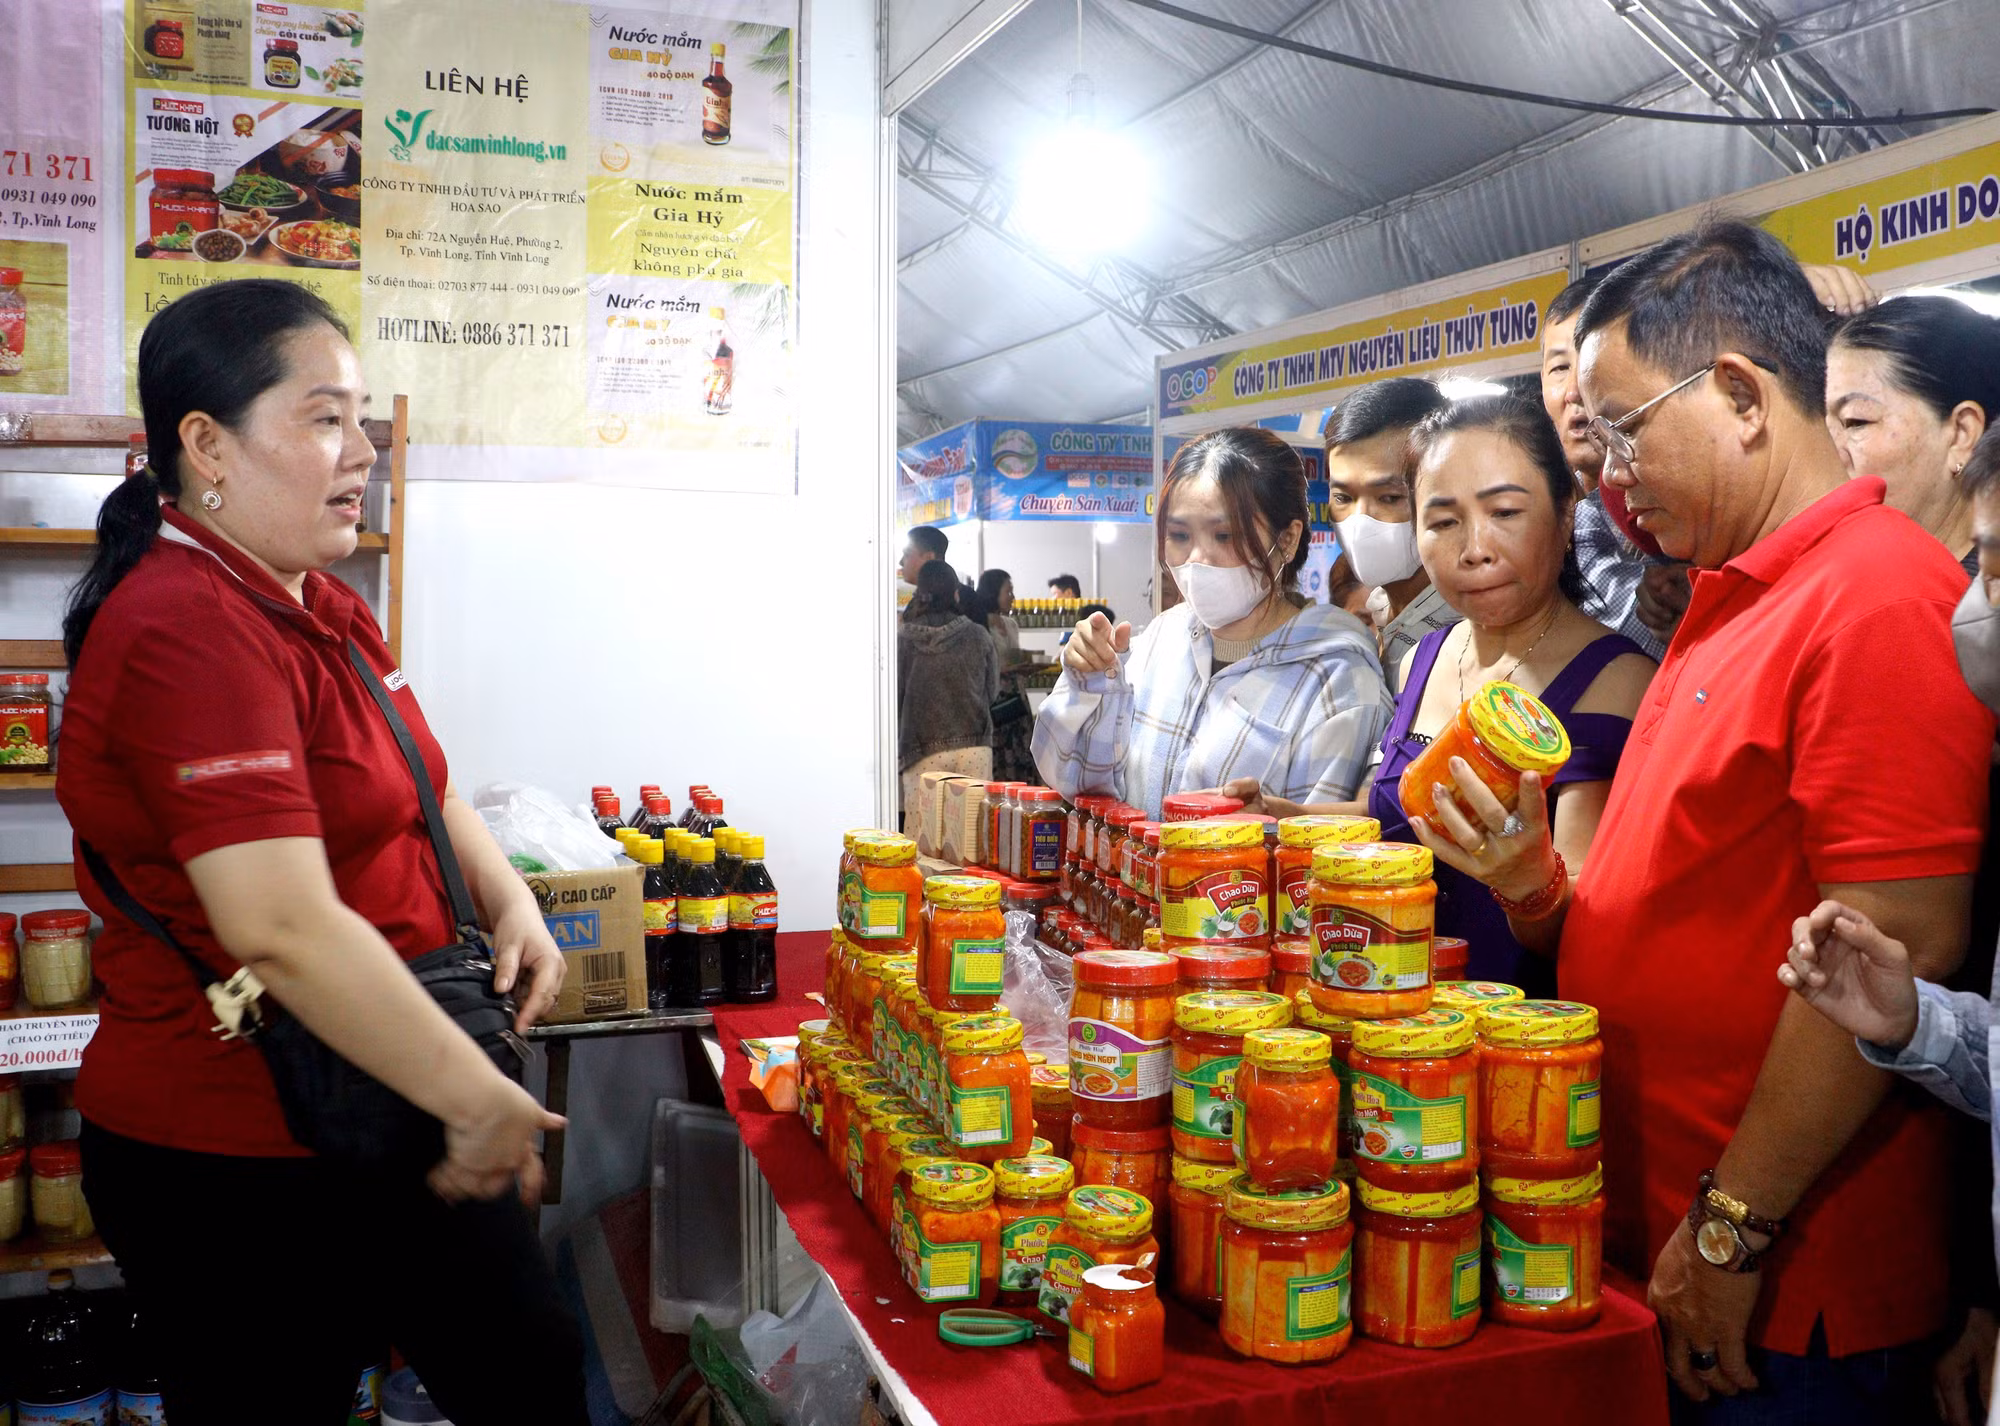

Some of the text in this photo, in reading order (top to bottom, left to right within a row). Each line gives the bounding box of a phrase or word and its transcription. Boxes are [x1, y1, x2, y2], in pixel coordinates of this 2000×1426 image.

[608, 26, 702, 50] Nước mắm
[609, 47, 643, 62] GIA
[426, 67, 529, 104] LIÊN HỆ
[146, 115, 220, 138] TƯƠNG HỘT
[426, 130, 567, 163] dacsanvinhlong.vn
[46, 154, 94, 182] 371
[1, 188, 97, 208] 0931 049 090
[362, 176, 586, 204] CÔNG TY TNHH ĐẦU TƯ VÀ PHÁT TRIỂN
[634, 183, 744, 204] Nước mắm
[450, 202, 502, 214] HOA SAO
[654, 208, 725, 228] Gia Hỷ
[12, 211, 97, 234] Tp.Vĩnh Long
[1836, 176, 2000, 262] HỘ KINH DO
[386, 228, 404, 240] Địa
[426, 231, 447, 243] 72A
[450, 232, 488, 248] Nguyễn
[516, 236, 552, 250] Phường
[400, 246, 416, 258] Tp.
[419, 246, 442, 258] Vĩnh
[500, 250, 524, 263] Vĩnh
[526, 252, 550, 266] Long
[640, 242, 700, 258] Nguyên
[634, 260, 681, 277] không
[722, 266, 744, 279] gia
[367, 274, 382, 287] Số
[383, 277, 406, 289] điện
[408, 278, 436, 291] thoại:
[438, 280, 468, 292] 02703
[470, 282, 488, 293] 877
[490, 282, 508, 294] 444
[516, 284, 540, 295] 0931
[542, 284, 561, 296] 049
[376, 316, 571, 348] HOTLINE: 0886 371 371
[1233, 362, 1265, 398] CÔNG
[1267, 359, 1282, 391] TY
[1282, 351, 1316, 388] TNHH
[1318, 344, 1346, 382] MTV
[1348, 327, 1405, 376] NGUYÊN
[1444, 304, 1488, 356] THỦY
[1489, 297, 1539, 348] TÙNG
[1167, 366, 1217, 401] OCOP
[1052, 428, 1095, 452] CÔNG
[1097, 434, 1118, 452] TY
[1020, 493, 1073, 514] Chuyên
[562, 889, 588, 904] CAO
[591, 884, 617, 902] CẤP
[1219, 889, 1241, 902] Chao
[1294, 888, 1308, 898] Cha
[1322, 928, 1363, 942] Chao Dừa
[7, 1035, 42, 1046] (CHAO
[1098, 1056, 1117, 1066] NGỌT
[1021, 1256, 1041, 1264] Chao
[1054, 1281, 1071, 1293] Chao
